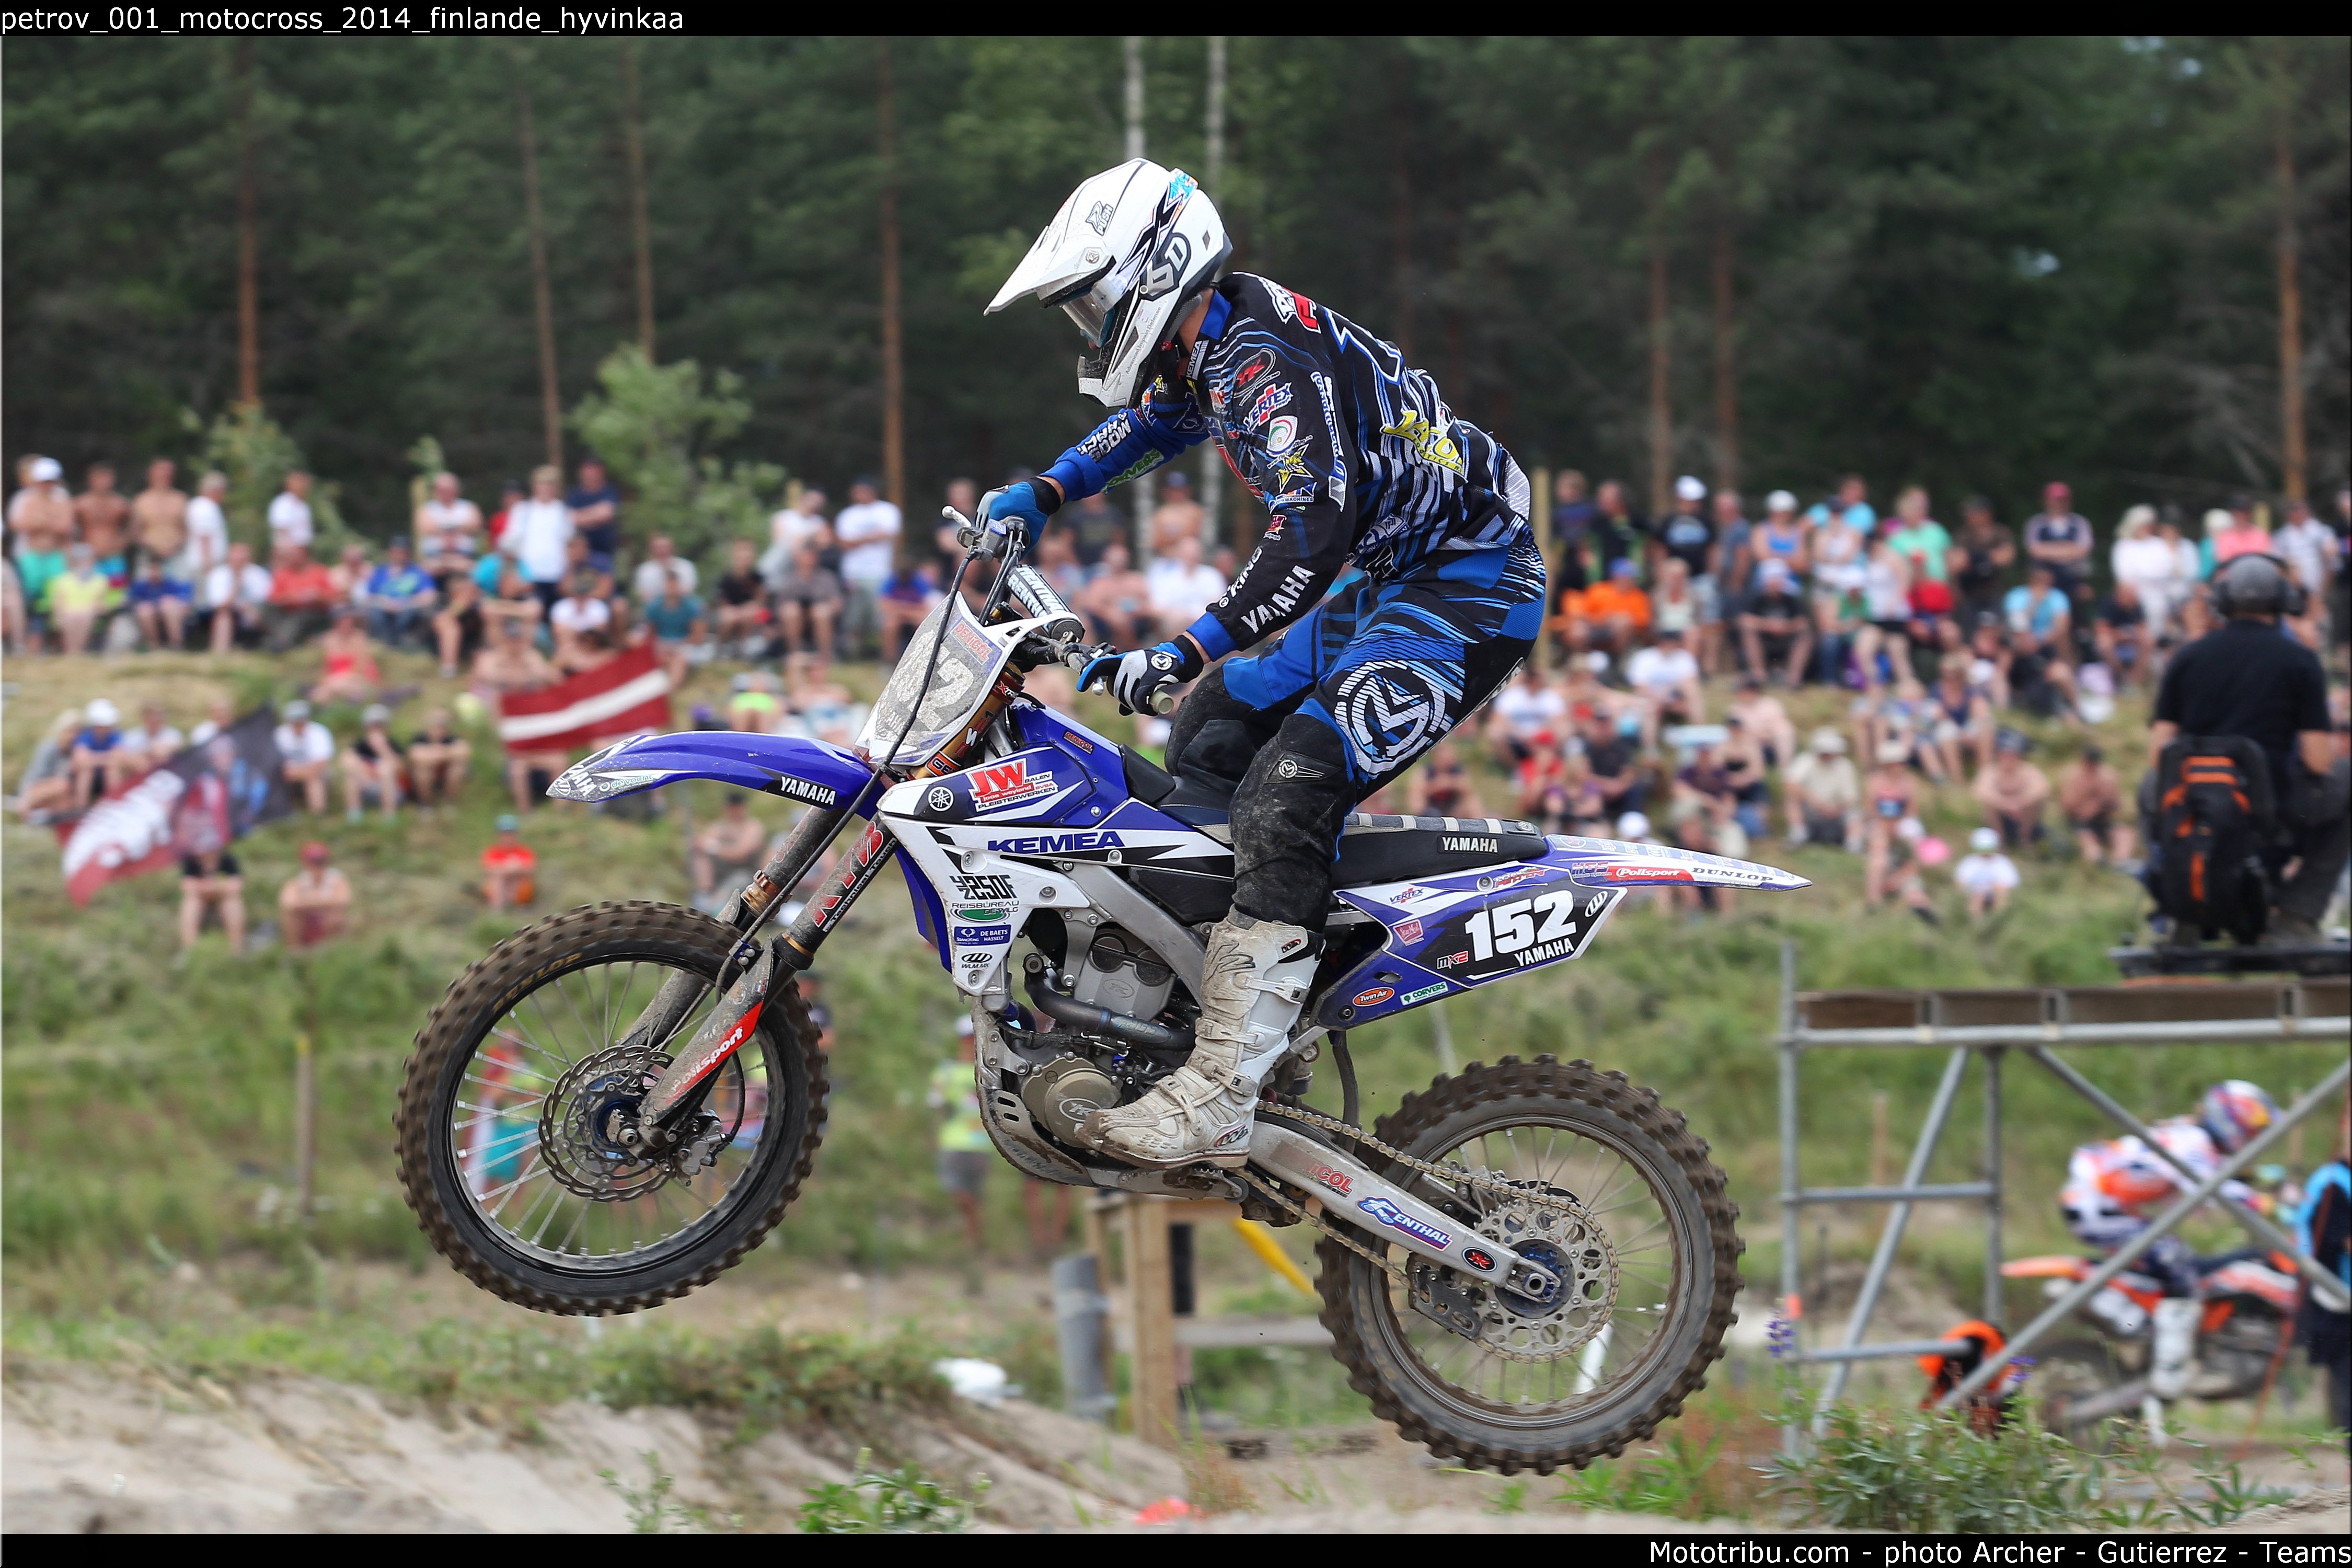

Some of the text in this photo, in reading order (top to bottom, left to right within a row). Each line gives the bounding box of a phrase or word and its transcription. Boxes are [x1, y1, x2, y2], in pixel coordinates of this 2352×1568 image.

[1125, 348, 1140, 374] Advanced
[1138, 329, 1150, 350] Impact
[1147, 306, 1161, 330] Defense
[1186, 341, 1202, 378] KEMEA
[1244, 384, 1290, 430] VERTEX
[971, 762, 1023, 797] JW
[1024, 774, 1050, 783] BALEN
[781, 776, 836, 805] YAMAHA
[978, 786, 1055, 809] PLEISTERWERKEN
[987, 831, 1125, 854] KEMEA
[1442, 836, 1498, 853] YAMAHA
[869, 839, 897, 872] Touch
[1572, 861, 1609, 874] HGS
[1691, 867, 1773, 882] DUNLOP
[952, 900, 1020, 909] REISBUREAU
[1389, 887, 1424, 904] VERTEX
[1465, 890, 1577, 962] 152
[1438, 950, 1469, 969] MX2
[1514, 937, 1575, 967] YAMAHA
[1360, 993, 1377, 1002] Twin
[1412, 983, 1446, 998] CORVERS
